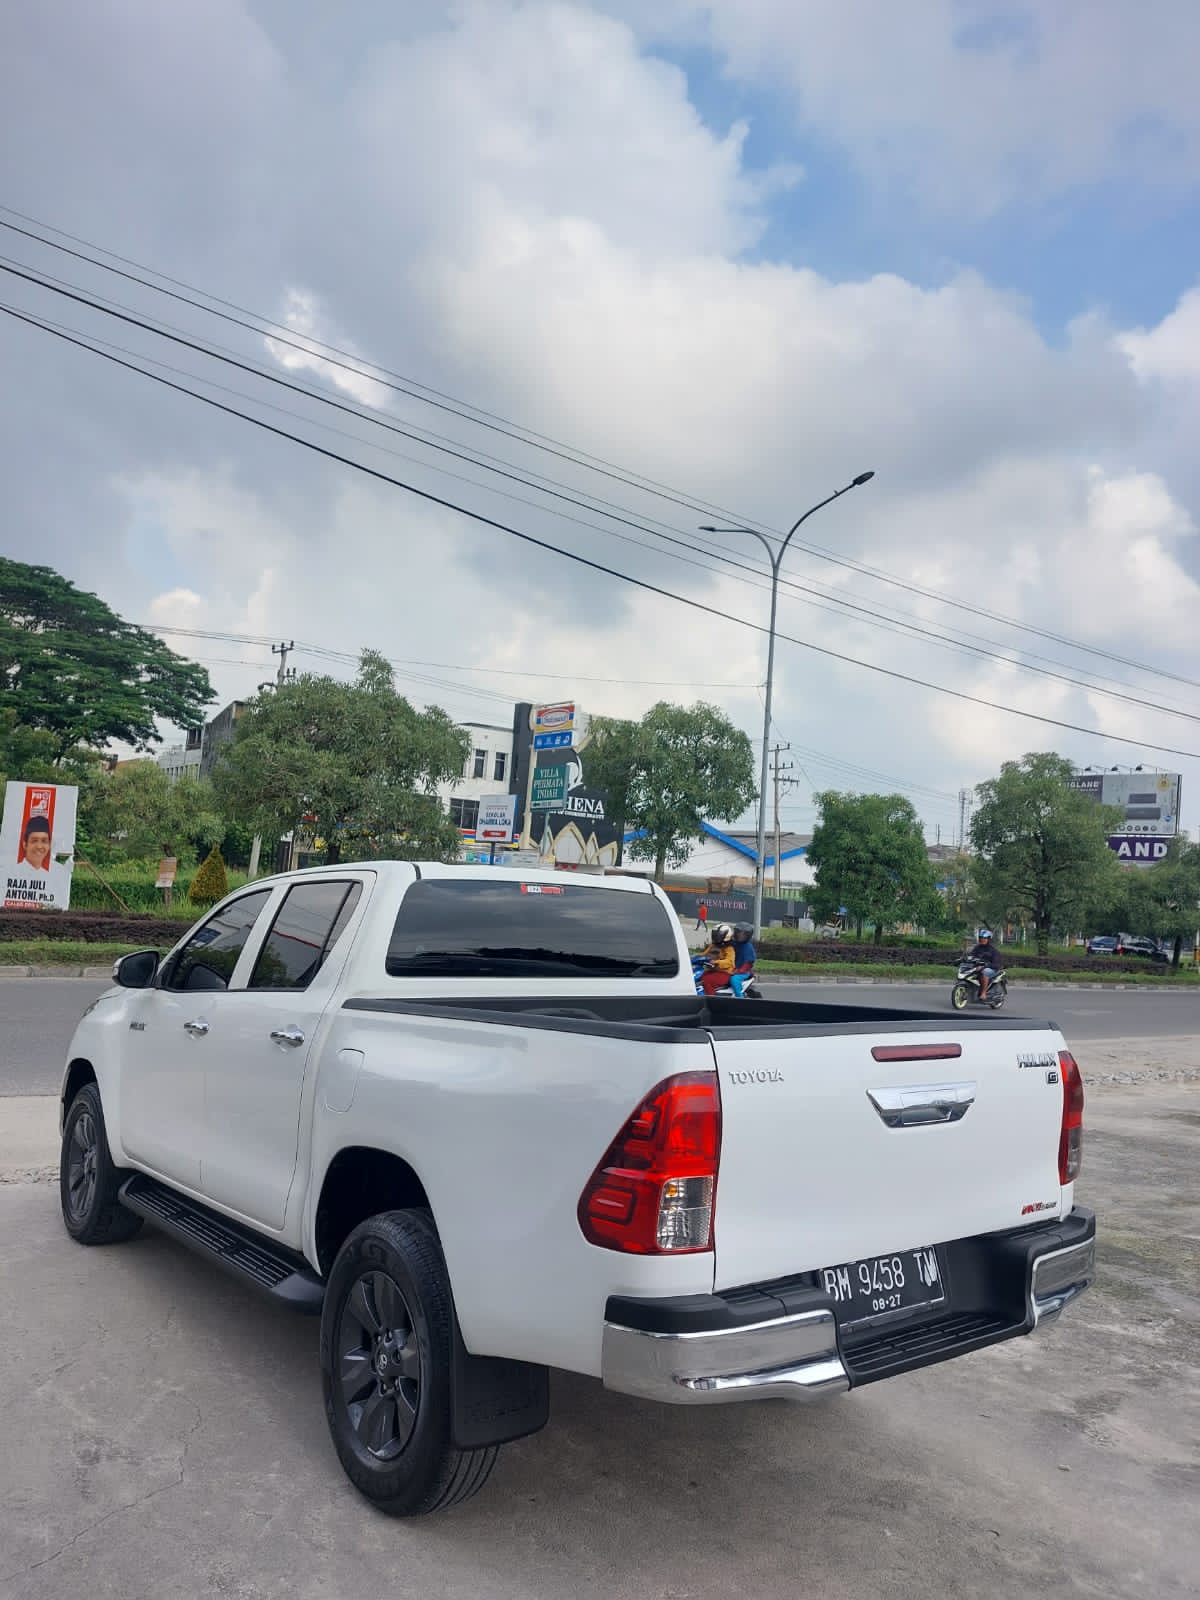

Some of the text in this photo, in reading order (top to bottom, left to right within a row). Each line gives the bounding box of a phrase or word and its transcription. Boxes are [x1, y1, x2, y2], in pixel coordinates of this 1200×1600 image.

[540, 767, 559, 778] VILLA
[1106, 841, 1168, 858] AND
[7, 878, 46, 891] RAJA JULI
[728, 1068, 785, 1085] TOYOTA
[858, 1256, 906, 1296] 9458
